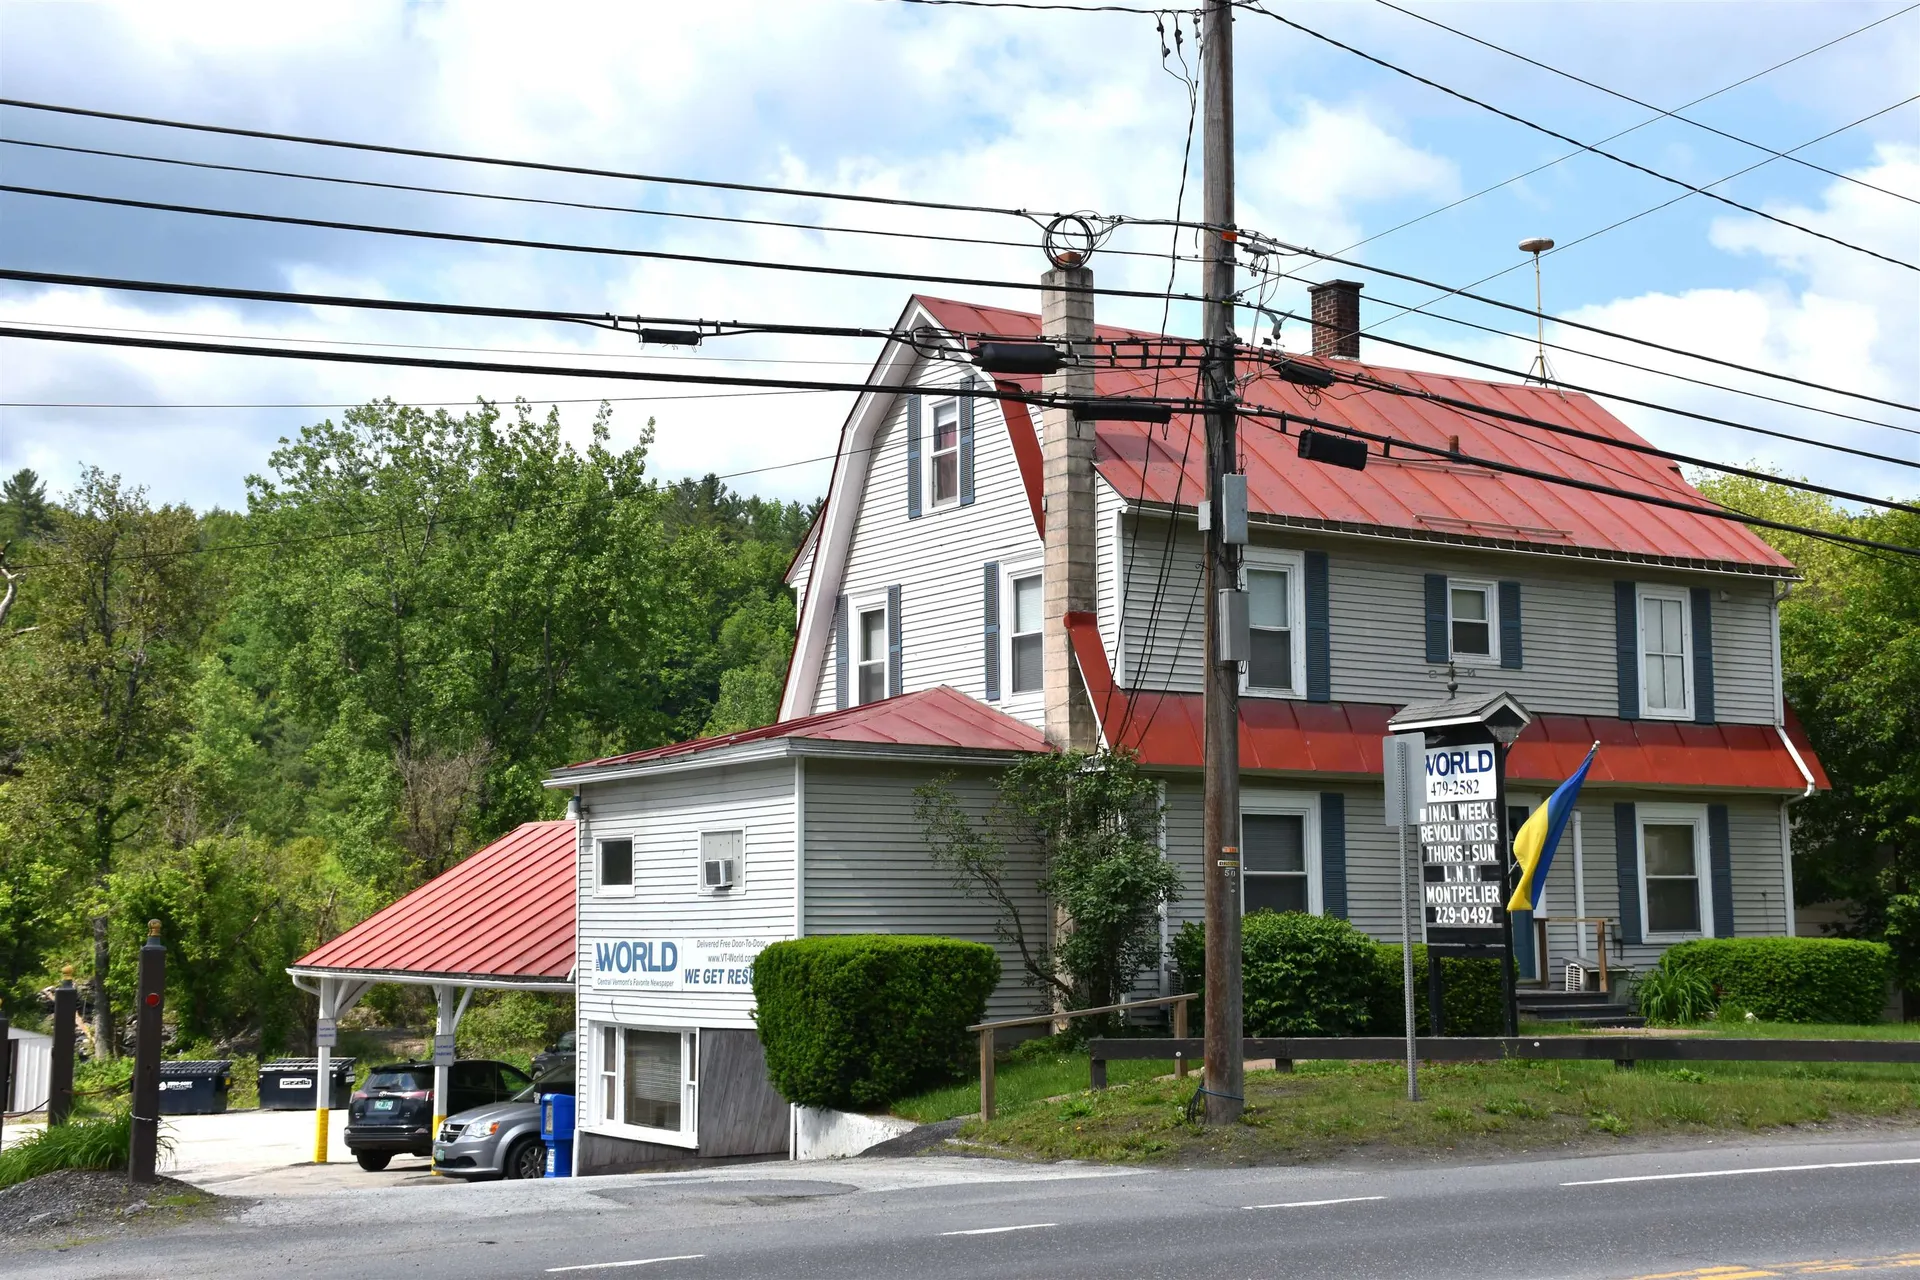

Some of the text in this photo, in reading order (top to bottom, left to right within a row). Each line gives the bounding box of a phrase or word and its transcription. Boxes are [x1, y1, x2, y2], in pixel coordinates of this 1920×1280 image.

[1431, 779, 1480, 797] 479-2582
[1429, 802, 1495, 822] INAL WEEK!
[1421, 823, 1498, 843] REVOLU'NISTS
[1426, 885, 1500, 904] MONTPELIER
[1435, 907, 1493, 924] 229-0492
[697, 940, 719, 949] Delivered
[720, 939, 731, 948] Free
[596, 941, 678, 973] WORLD
[597, 978, 674, 987] Central Vermont's Favorite Newspaper
[685, 968, 700, 984] WE
[703, 968, 724, 985] GET
